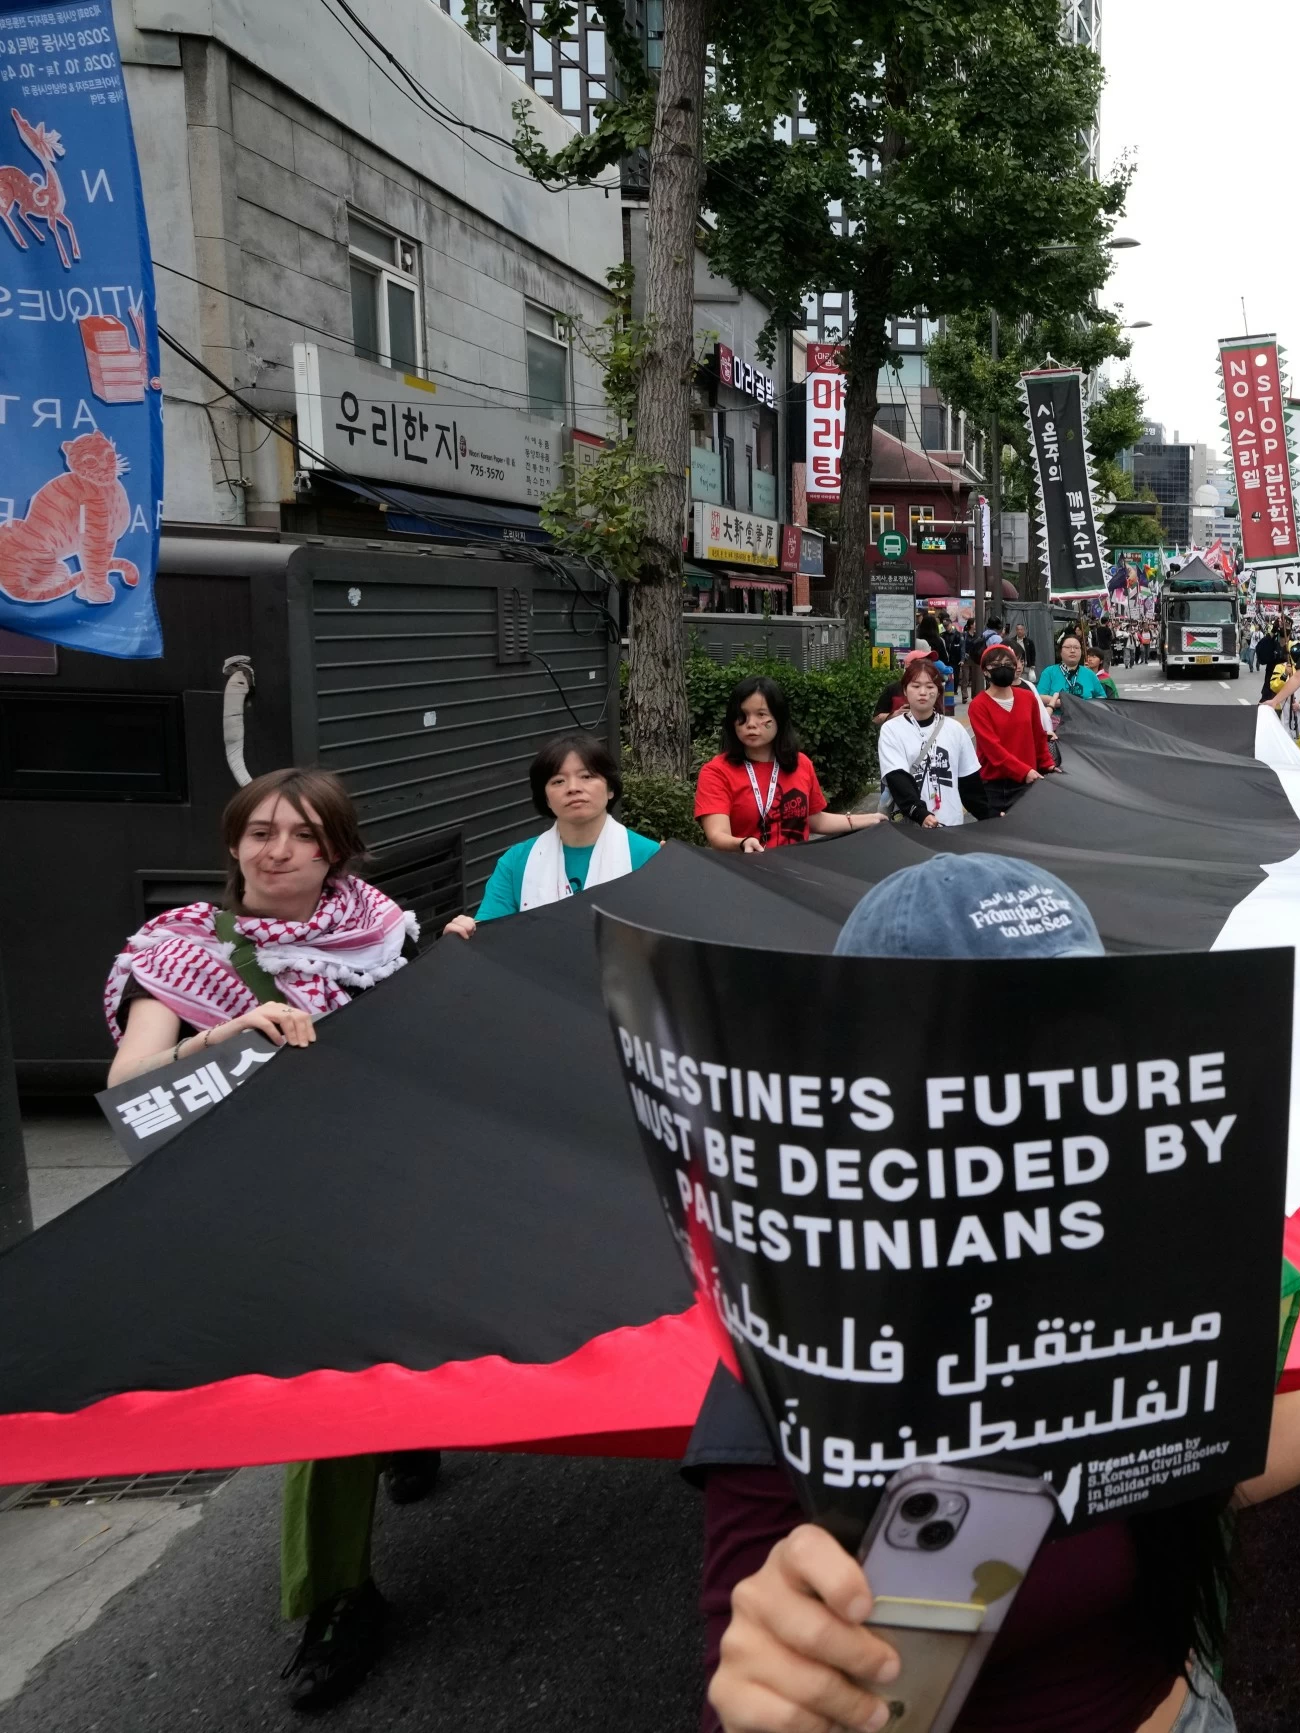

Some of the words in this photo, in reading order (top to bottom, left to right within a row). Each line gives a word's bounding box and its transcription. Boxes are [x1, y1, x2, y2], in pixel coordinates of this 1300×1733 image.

[733, 355, 776, 409] 마라공방
[1229, 359, 1250, 399] NO
[1256, 374, 1279, 456] STOP
[335, 391, 460, 470] 우리한지
[812, 379, 847, 489] 마라탕
[1037, 401, 1063, 482] 시온주의
[1234, 406, 1261, 490] 이스라엘
[1065, 490, 1096, 570] 깨부수고
[1263, 463, 1292, 547] 집단학살
[783, 796, 802, 811] STOP
[968, 909, 1018, 929] From
[1015, 904, 1042, 920] the
[998, 925, 1020, 938] to
[1018, 919, 1045, 936] the
[1040, 913, 1073, 932] Sea
[926, 1051, 1227, 1131] FUTURE
[627, 1081, 694, 1162] MUST
[702, 1125, 760, 1188] BE
[777, 1133, 1110, 1203] DECIDED
[1144, 1112, 1238, 1175] BY
[675, 1168, 1107, 1271] PALESTINIANS
[1087, 1452, 1136, 1475] Urgent
[1137, 1440, 1184, 1463] Action
[1184, 1436, 1202, 1450] by
[1104, 1471, 1170, 1498] Solidarity
[1171, 1460, 1201, 1478] with
[1151, 1451, 1182, 1472] Civil
[1183, 1440, 1231, 1462] Society
[1087, 1488, 1150, 1515] Palestine
